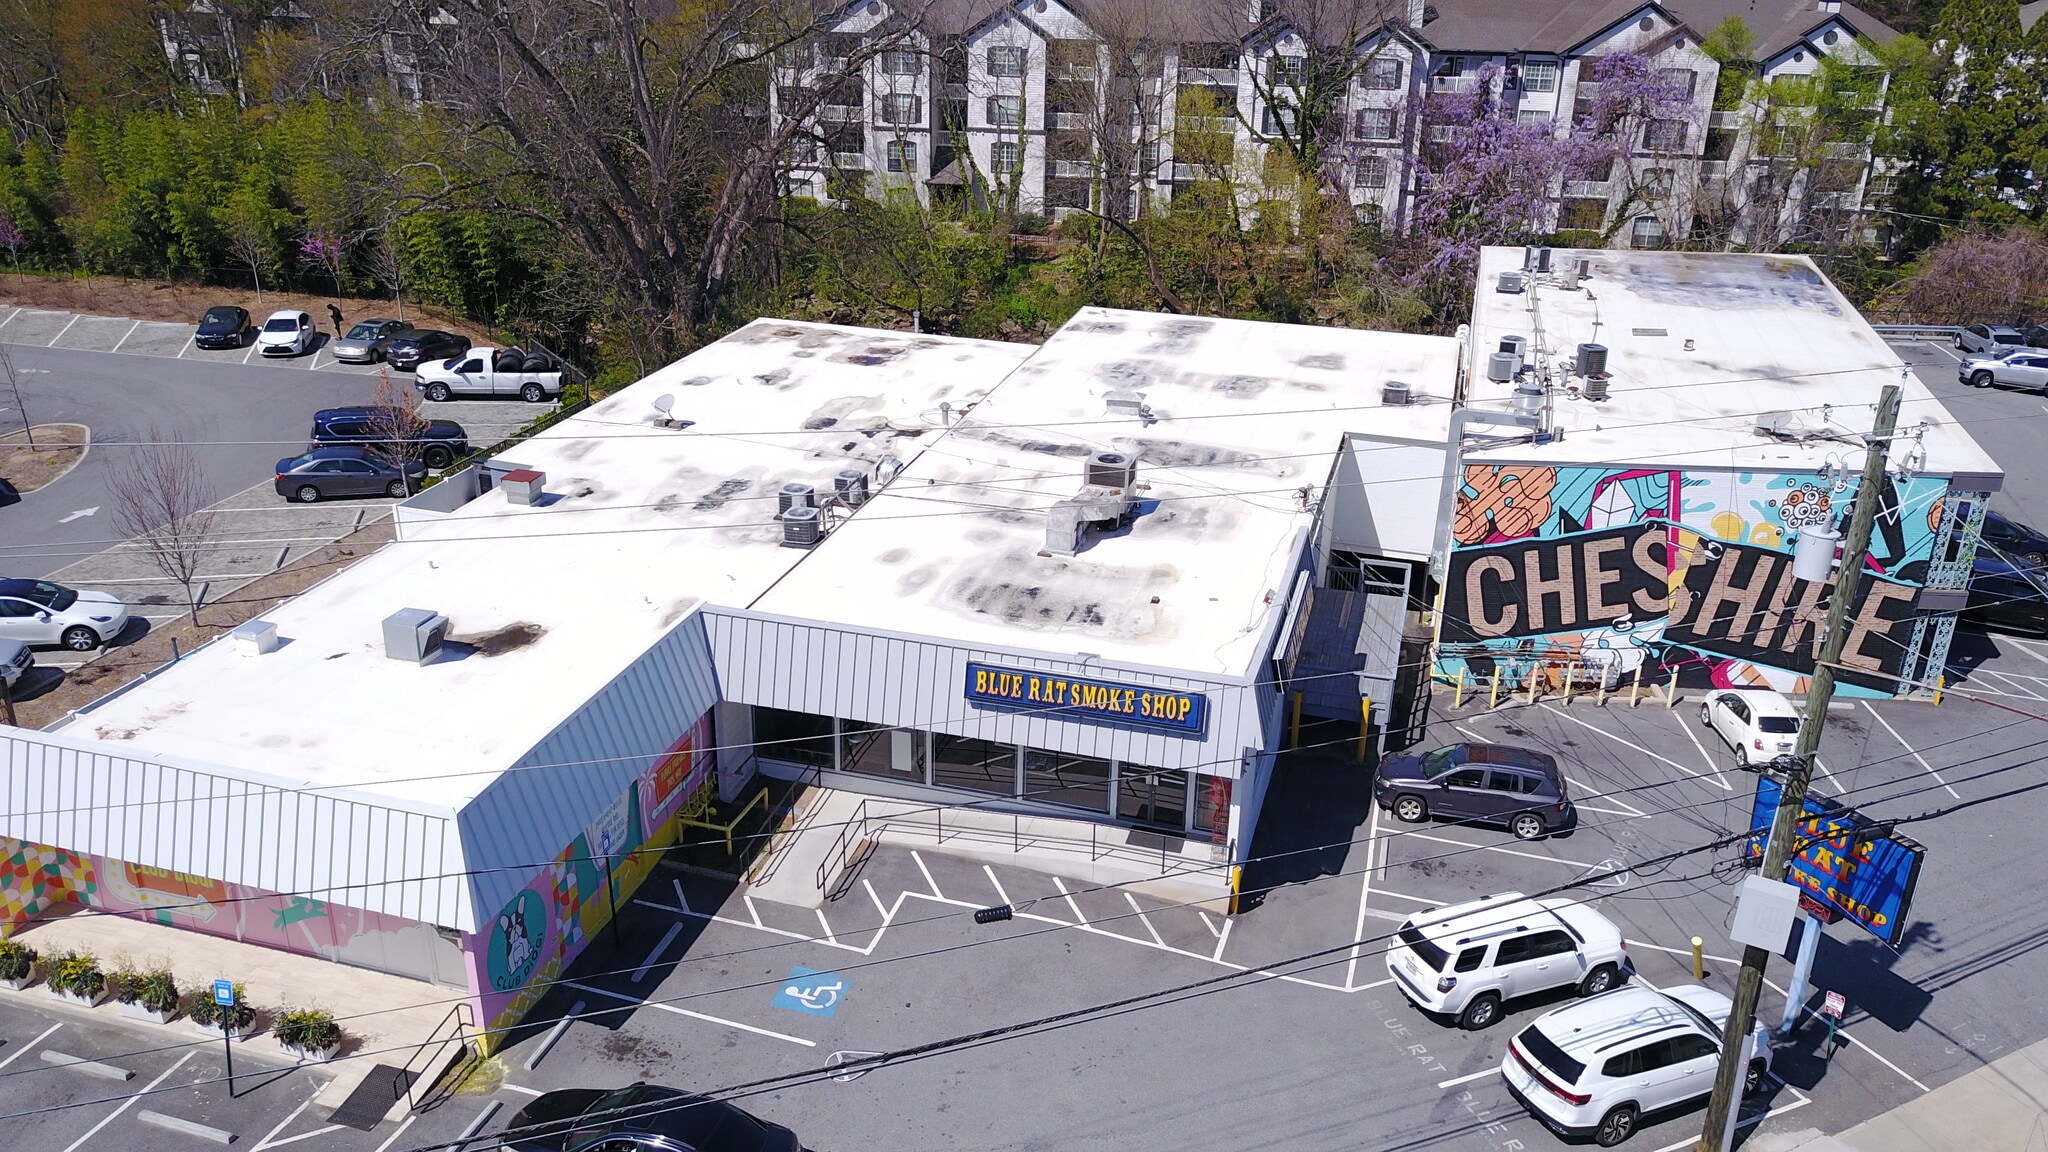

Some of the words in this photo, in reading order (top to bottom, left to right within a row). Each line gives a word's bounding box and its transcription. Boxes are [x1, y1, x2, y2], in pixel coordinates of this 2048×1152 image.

[975, 670, 1022, 698] BLUE
[1028, 677, 1067, 704] RAT
[1070, 684, 1135, 714] SMOKE
[1141, 693, 1191, 721] SHOP
[1826, 886, 1888, 928] SHOP
[496, 975, 521, 990] CLUB
[1407, 1043, 1447, 1073] RAT
[1457, 1091, 1507, 1134] BLUE
